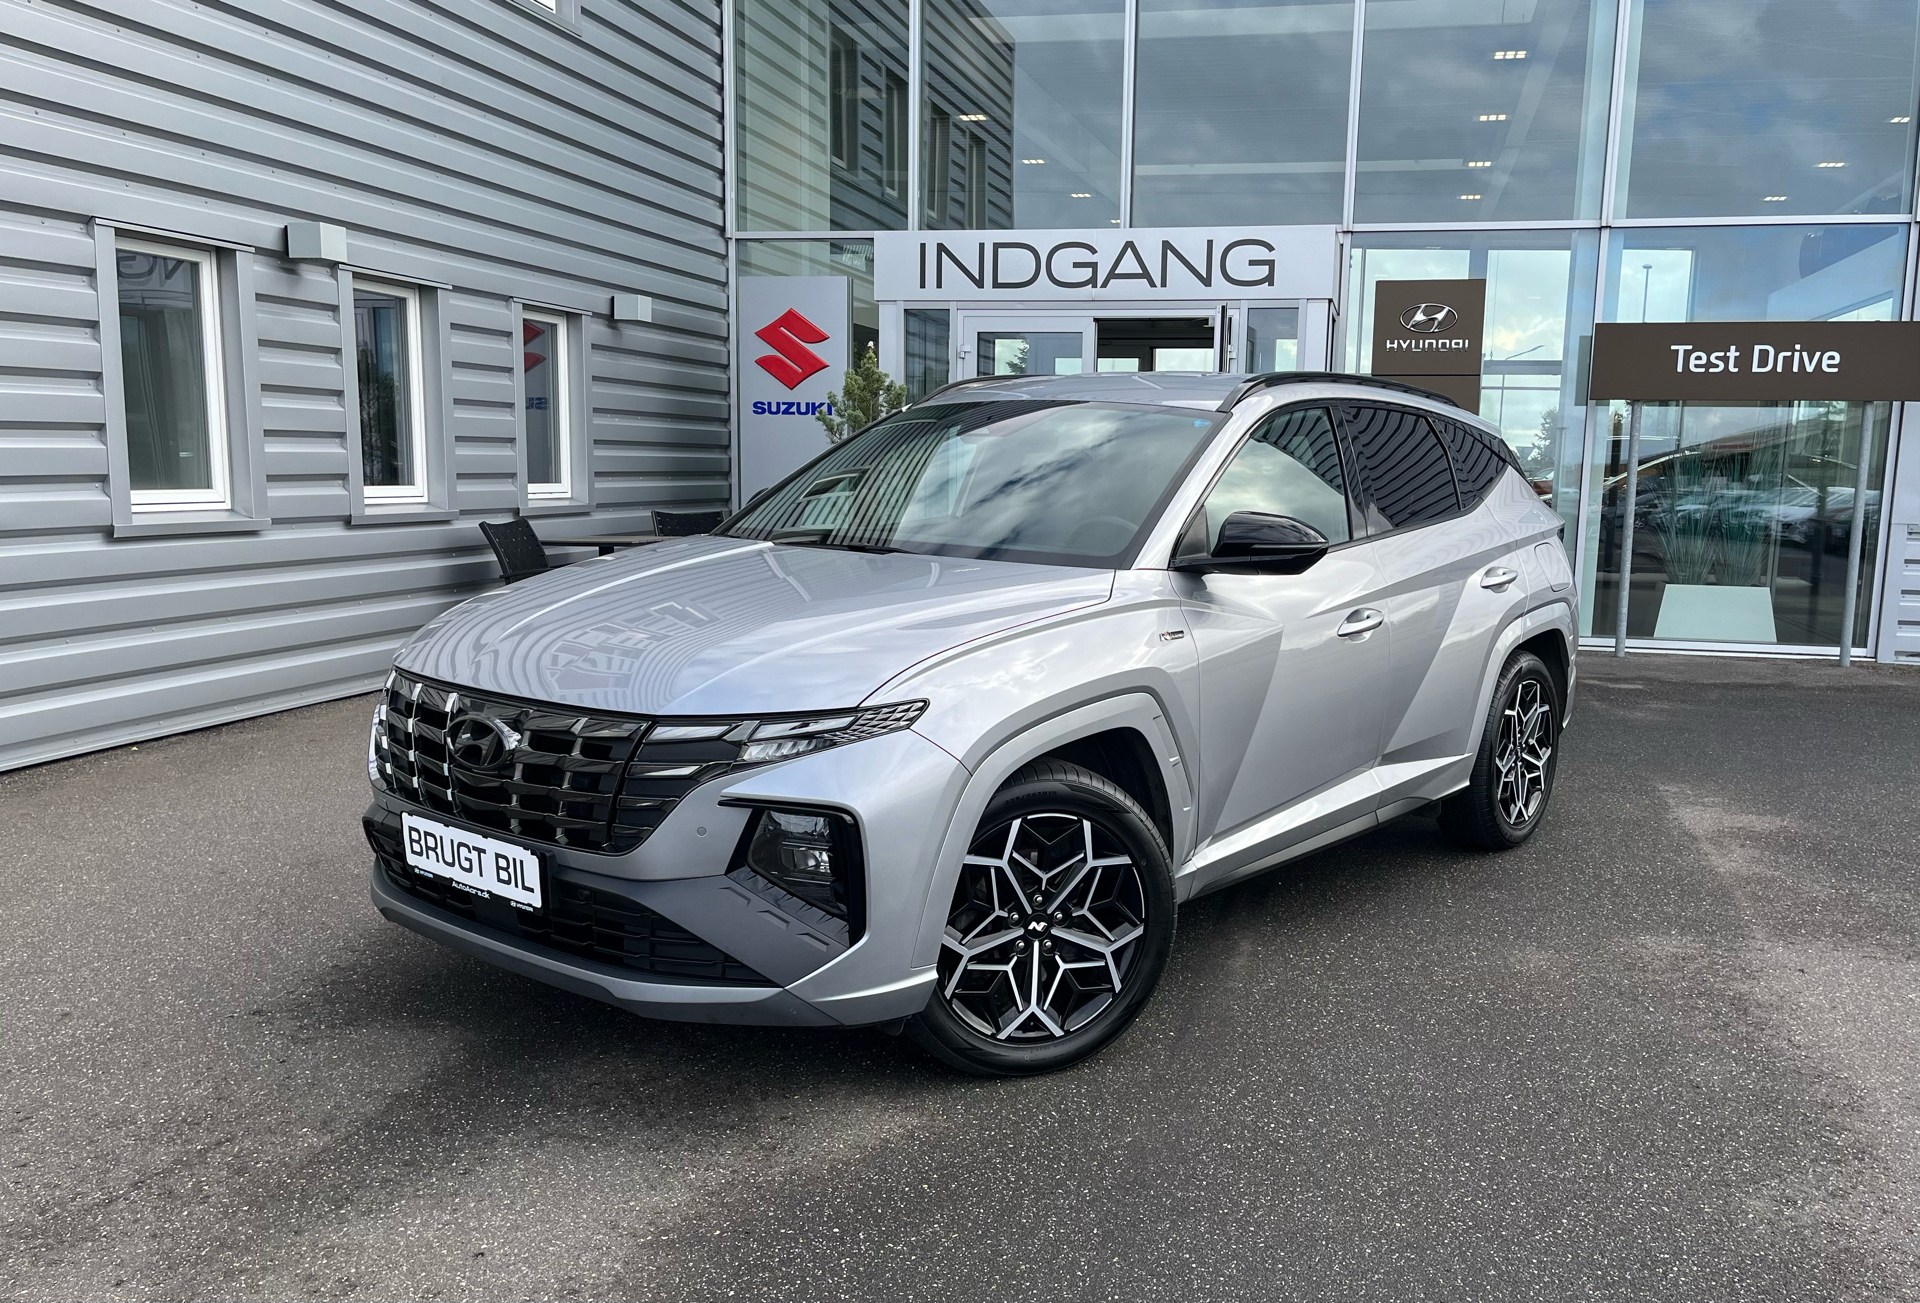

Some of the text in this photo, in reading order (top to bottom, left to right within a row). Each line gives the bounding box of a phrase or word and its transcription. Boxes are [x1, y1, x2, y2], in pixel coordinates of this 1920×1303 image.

[919, 238, 1276, 289] INDGANG
[1386, 339, 1469, 352] HYUNDAI
[1670, 343, 1841, 373] Test Drive
[752, 400, 833, 416] SUZUKI
[407, 825, 535, 894] BRUGT BIL
